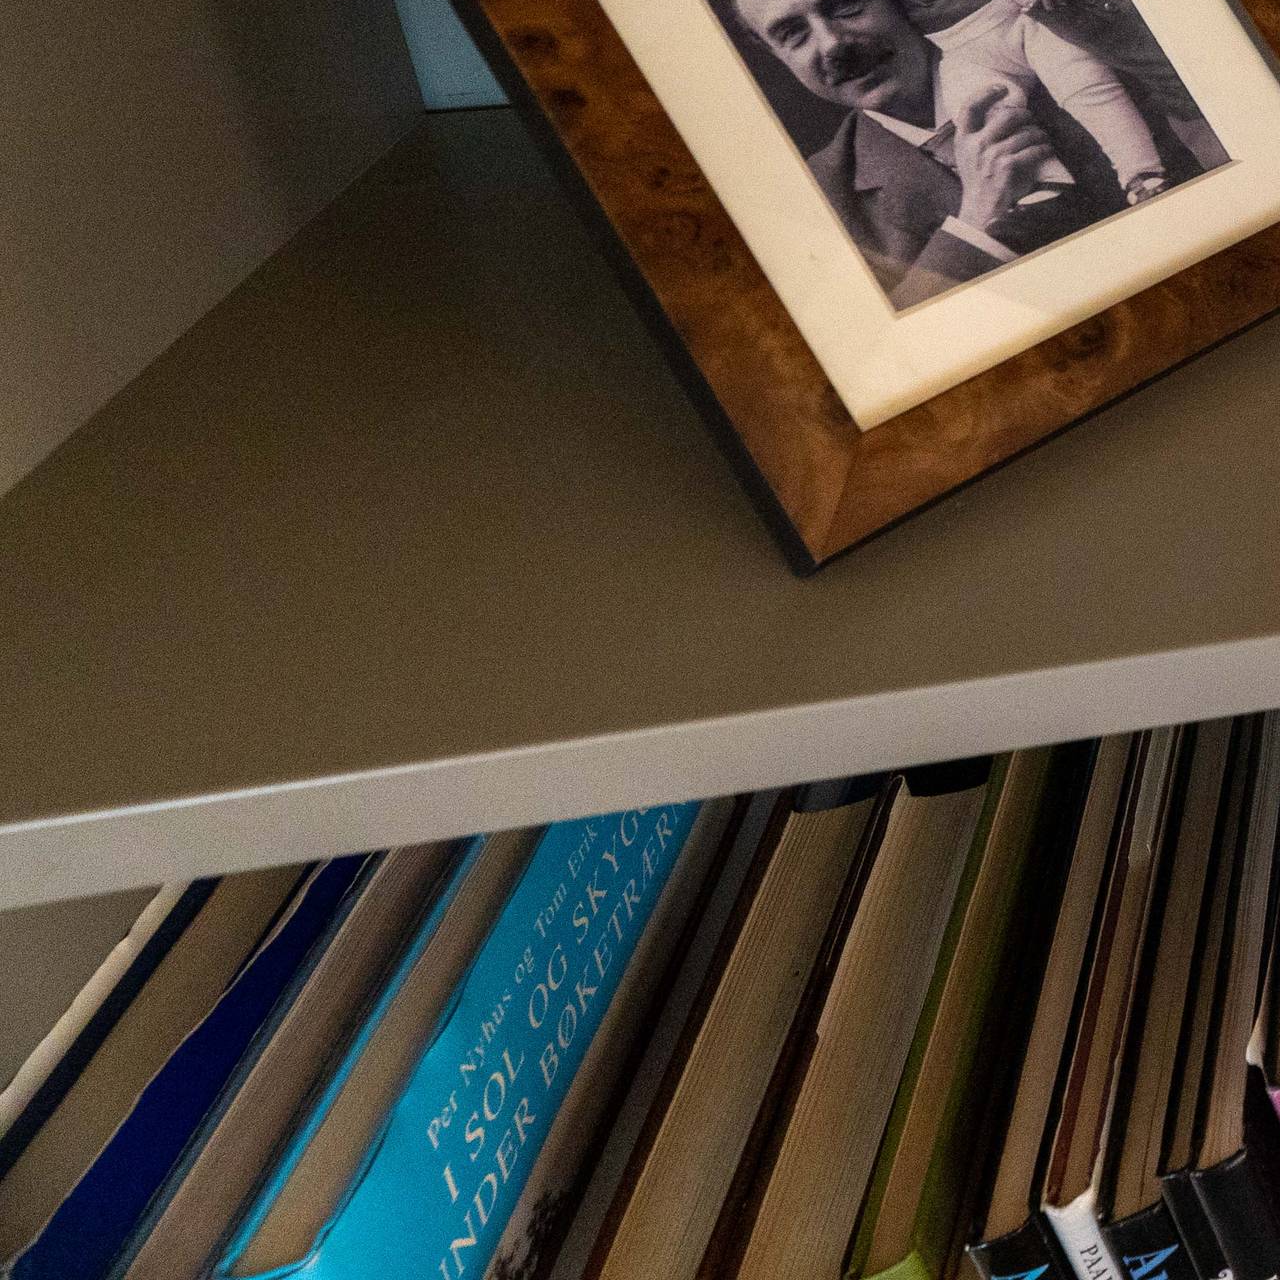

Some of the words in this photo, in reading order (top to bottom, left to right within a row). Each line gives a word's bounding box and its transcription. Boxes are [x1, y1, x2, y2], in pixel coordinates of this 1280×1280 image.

[427, 1089, 458, 1150] Per
[459, 987, 512, 1088] Nyhus
[514, 945, 535, 984] og
[534, 883, 567, 938] Tom
[567, 822, 598, 880] Erik
[443, 1163, 459, 1204] I
[465, 1048, 525, 1162] SOL
[528, 943, 568, 1029] OG
[572, 808, 649, 945] SKYG
[1079, 1244, 1114, 1280] PAA
